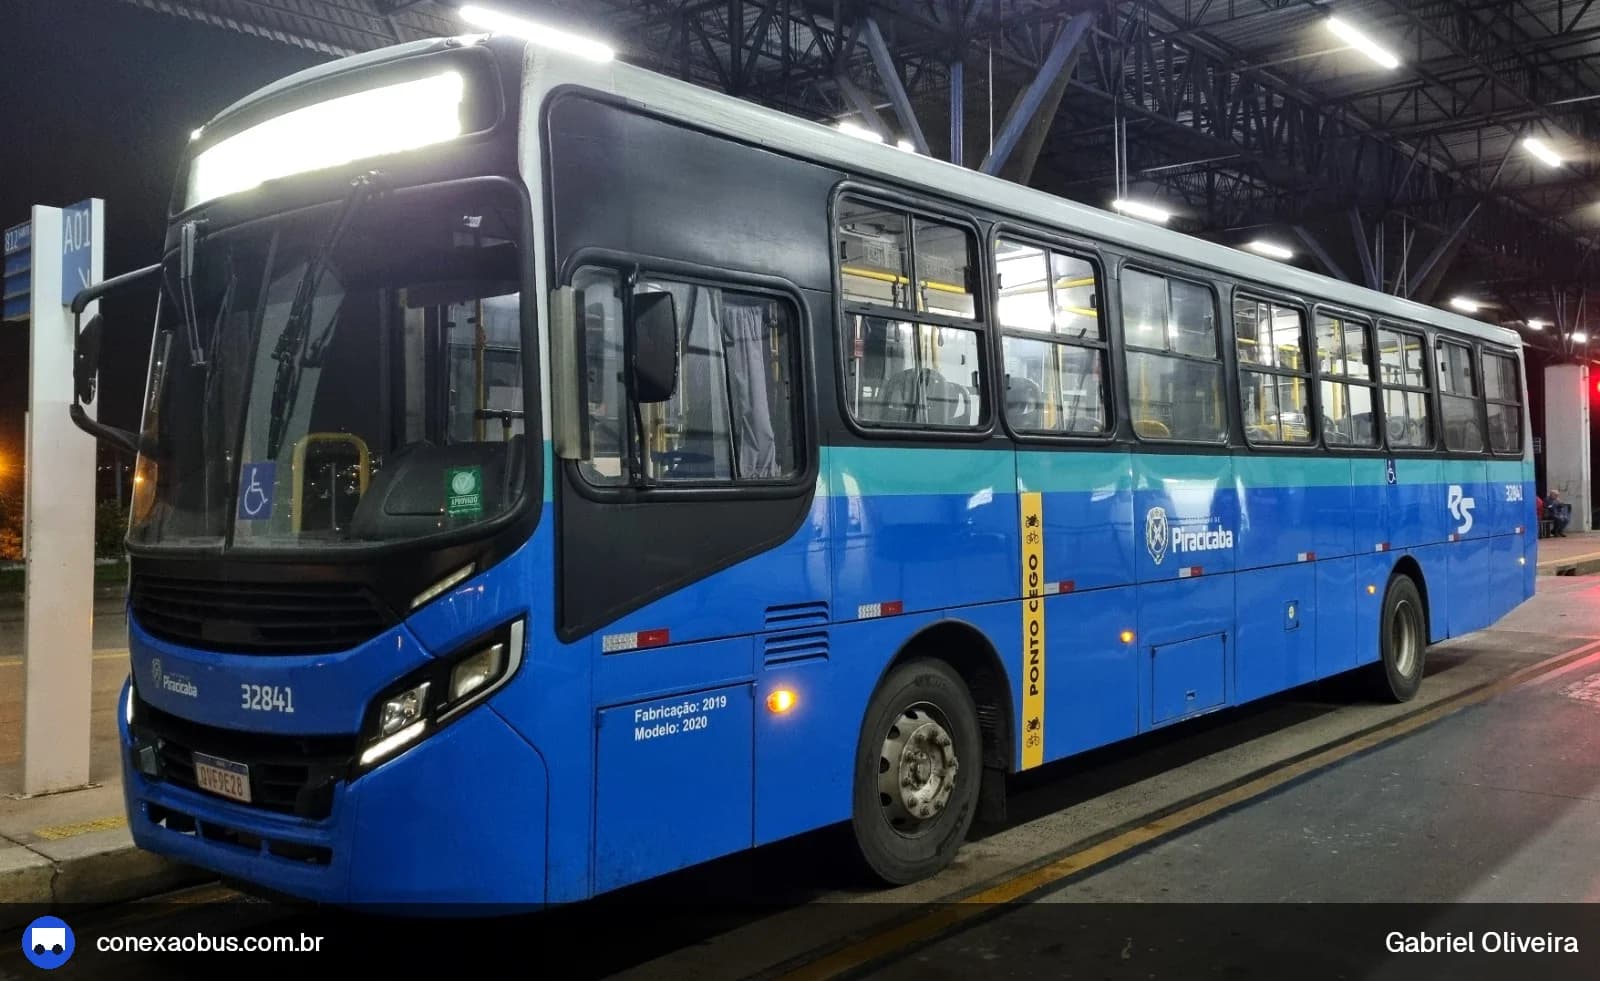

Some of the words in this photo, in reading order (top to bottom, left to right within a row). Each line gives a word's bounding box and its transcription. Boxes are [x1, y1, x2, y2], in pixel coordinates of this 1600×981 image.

[64, 208, 90, 254] A01
[1171, 523, 1234, 553] Piracicaba
[1028, 554, 1039, 612] CEGO
[1029, 619, 1040, 696] PONTO
[163, 674, 198, 698] Piracicaba
[240, 683, 295, 713] 32841
[634, 701, 699, 723] Fabricação:
[702, 695, 728, 711] 2019
[634, 725, 680, 741] Modelo:
[682, 716, 708, 732] 2020
